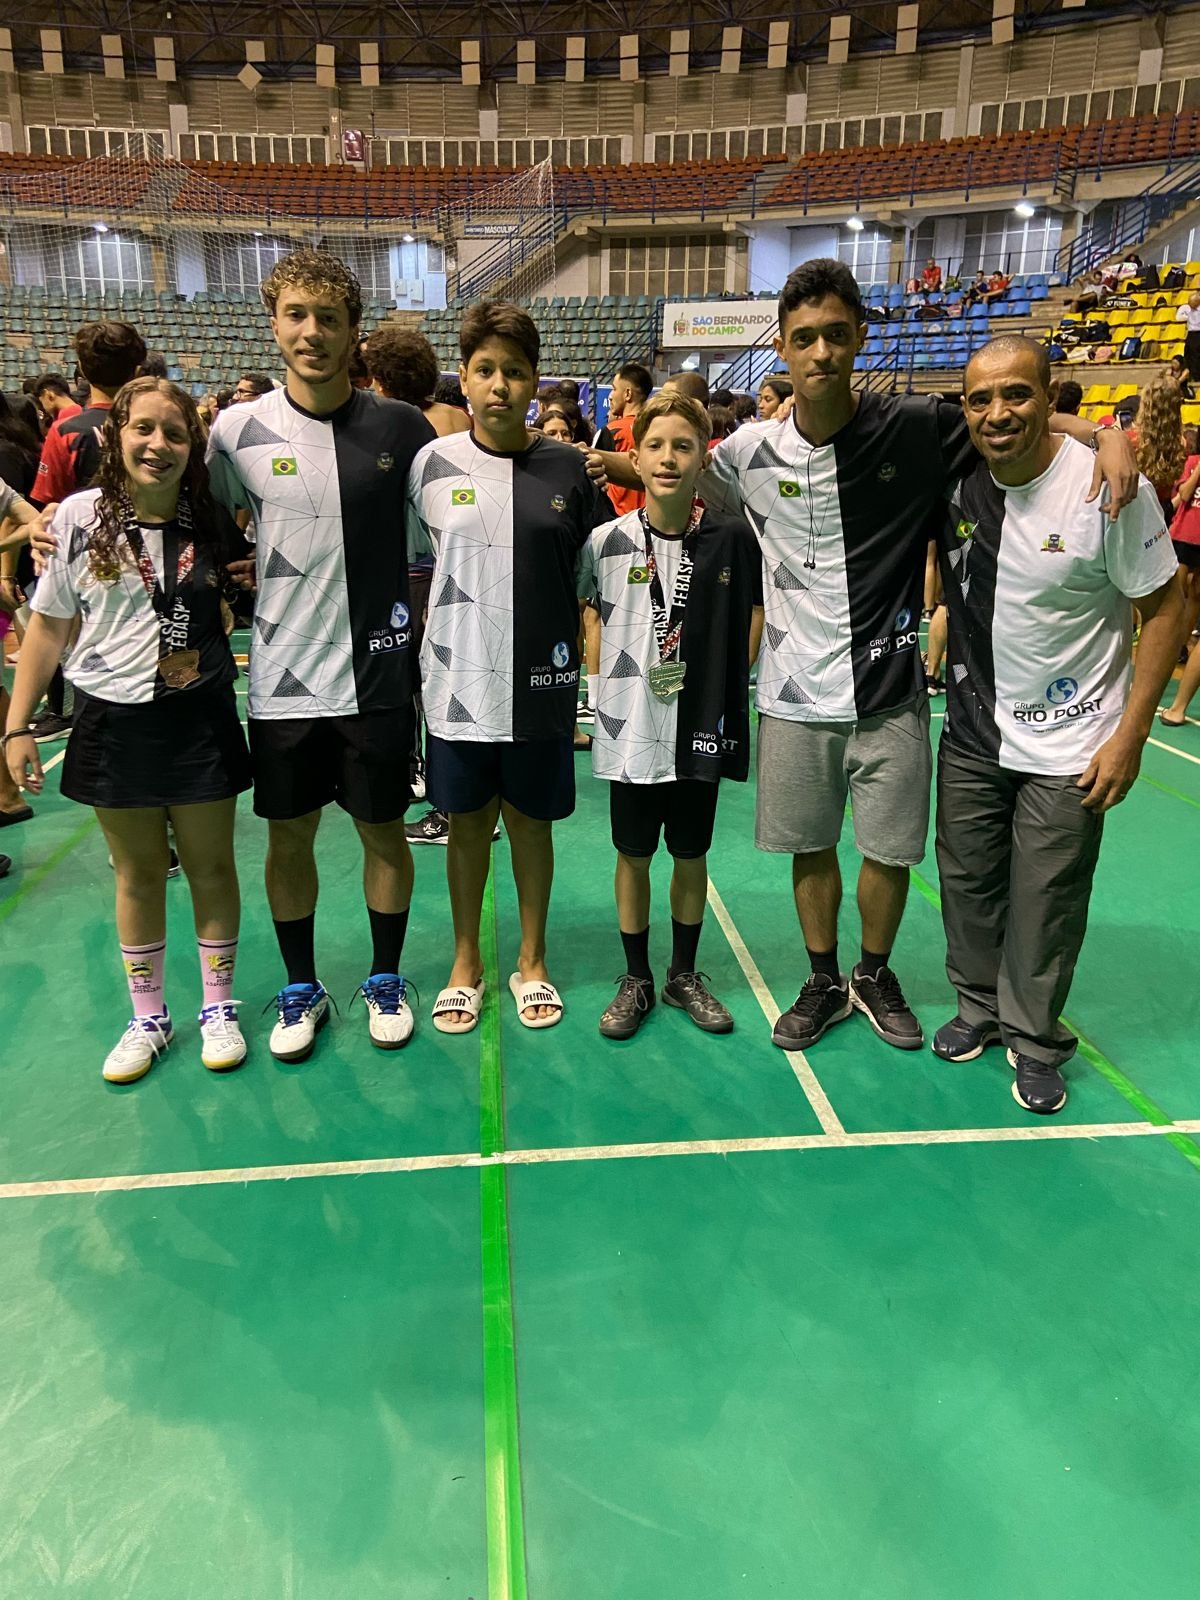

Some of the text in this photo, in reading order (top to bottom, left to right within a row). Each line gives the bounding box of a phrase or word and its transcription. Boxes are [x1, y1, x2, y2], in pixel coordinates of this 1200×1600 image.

[692, 314, 773, 326] SÃO BERNARDO
[692, 325, 745, 336] DO CAMPO
[672, 556, 694, 607] FEBASP
[171, 604, 190, 647] EBASP
[870, 637, 889, 647] GRU
[896, 632, 917, 649] PO
[530, 674, 552, 687] RIO
[1013, 698, 1103, 723] RIO PORT
[1014, 702, 1045, 710] GRUPO
[693, 731, 717, 741] GRUPO
[692, 738, 739, 754] RIO RT
[436, 998, 466, 1009] PUMA
[523, 992, 553, 1004] PUMA
